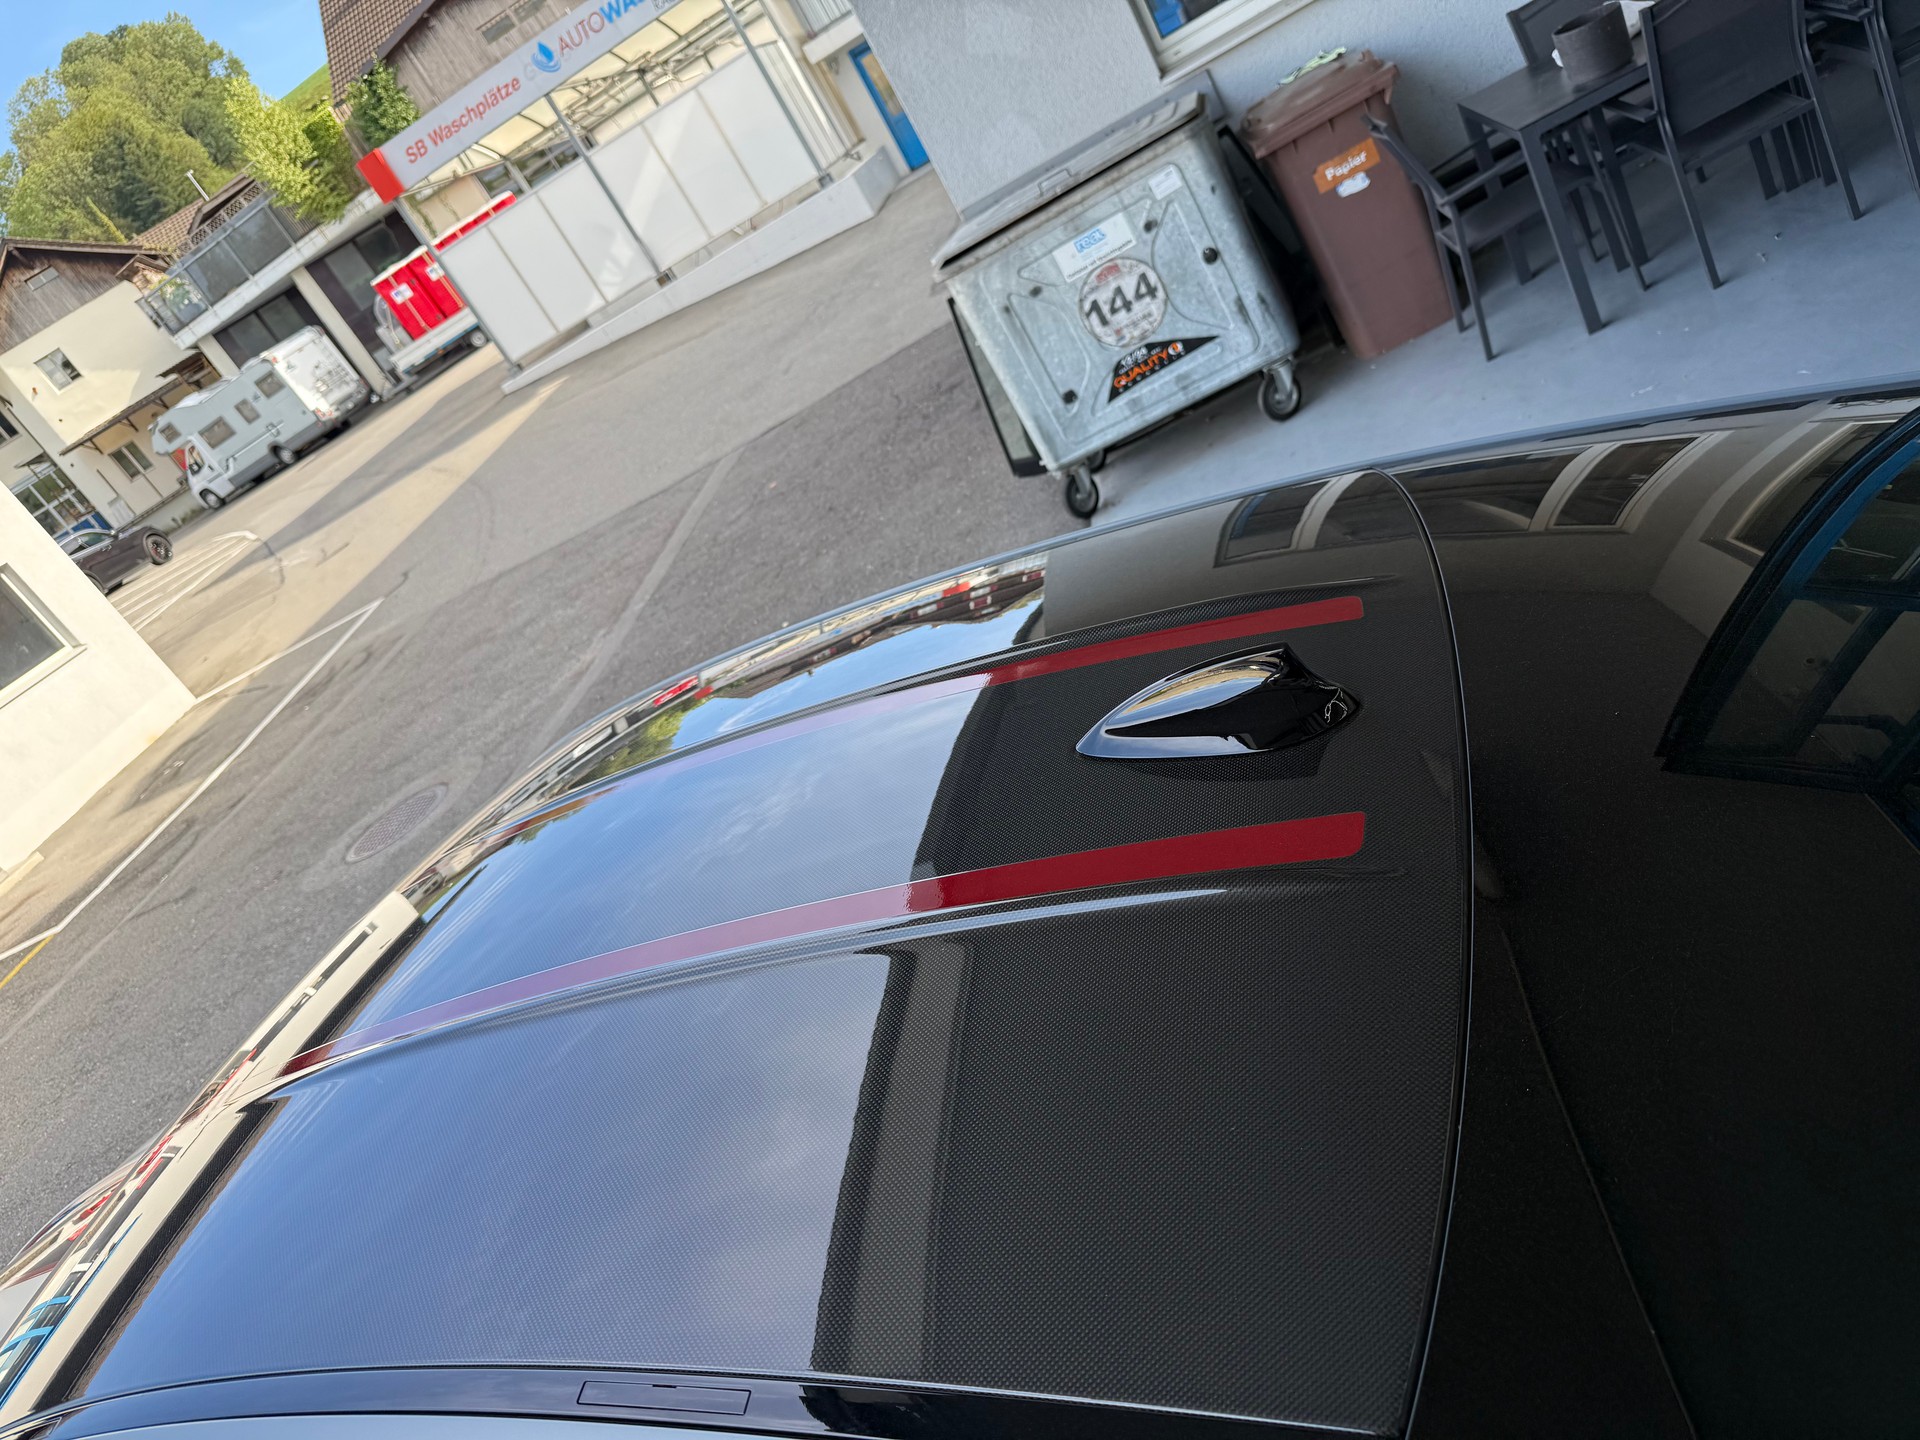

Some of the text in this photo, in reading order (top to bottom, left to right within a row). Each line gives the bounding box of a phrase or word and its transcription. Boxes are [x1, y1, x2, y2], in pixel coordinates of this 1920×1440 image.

[558, 0, 644, 58] AUTOWA
[405, 77, 521, 164] SB Waschplätze
[1325, 151, 1367, 181] Papier
[1085, 272, 1158, 327] 144
[1113, 349, 1168, 388] QUALITY
